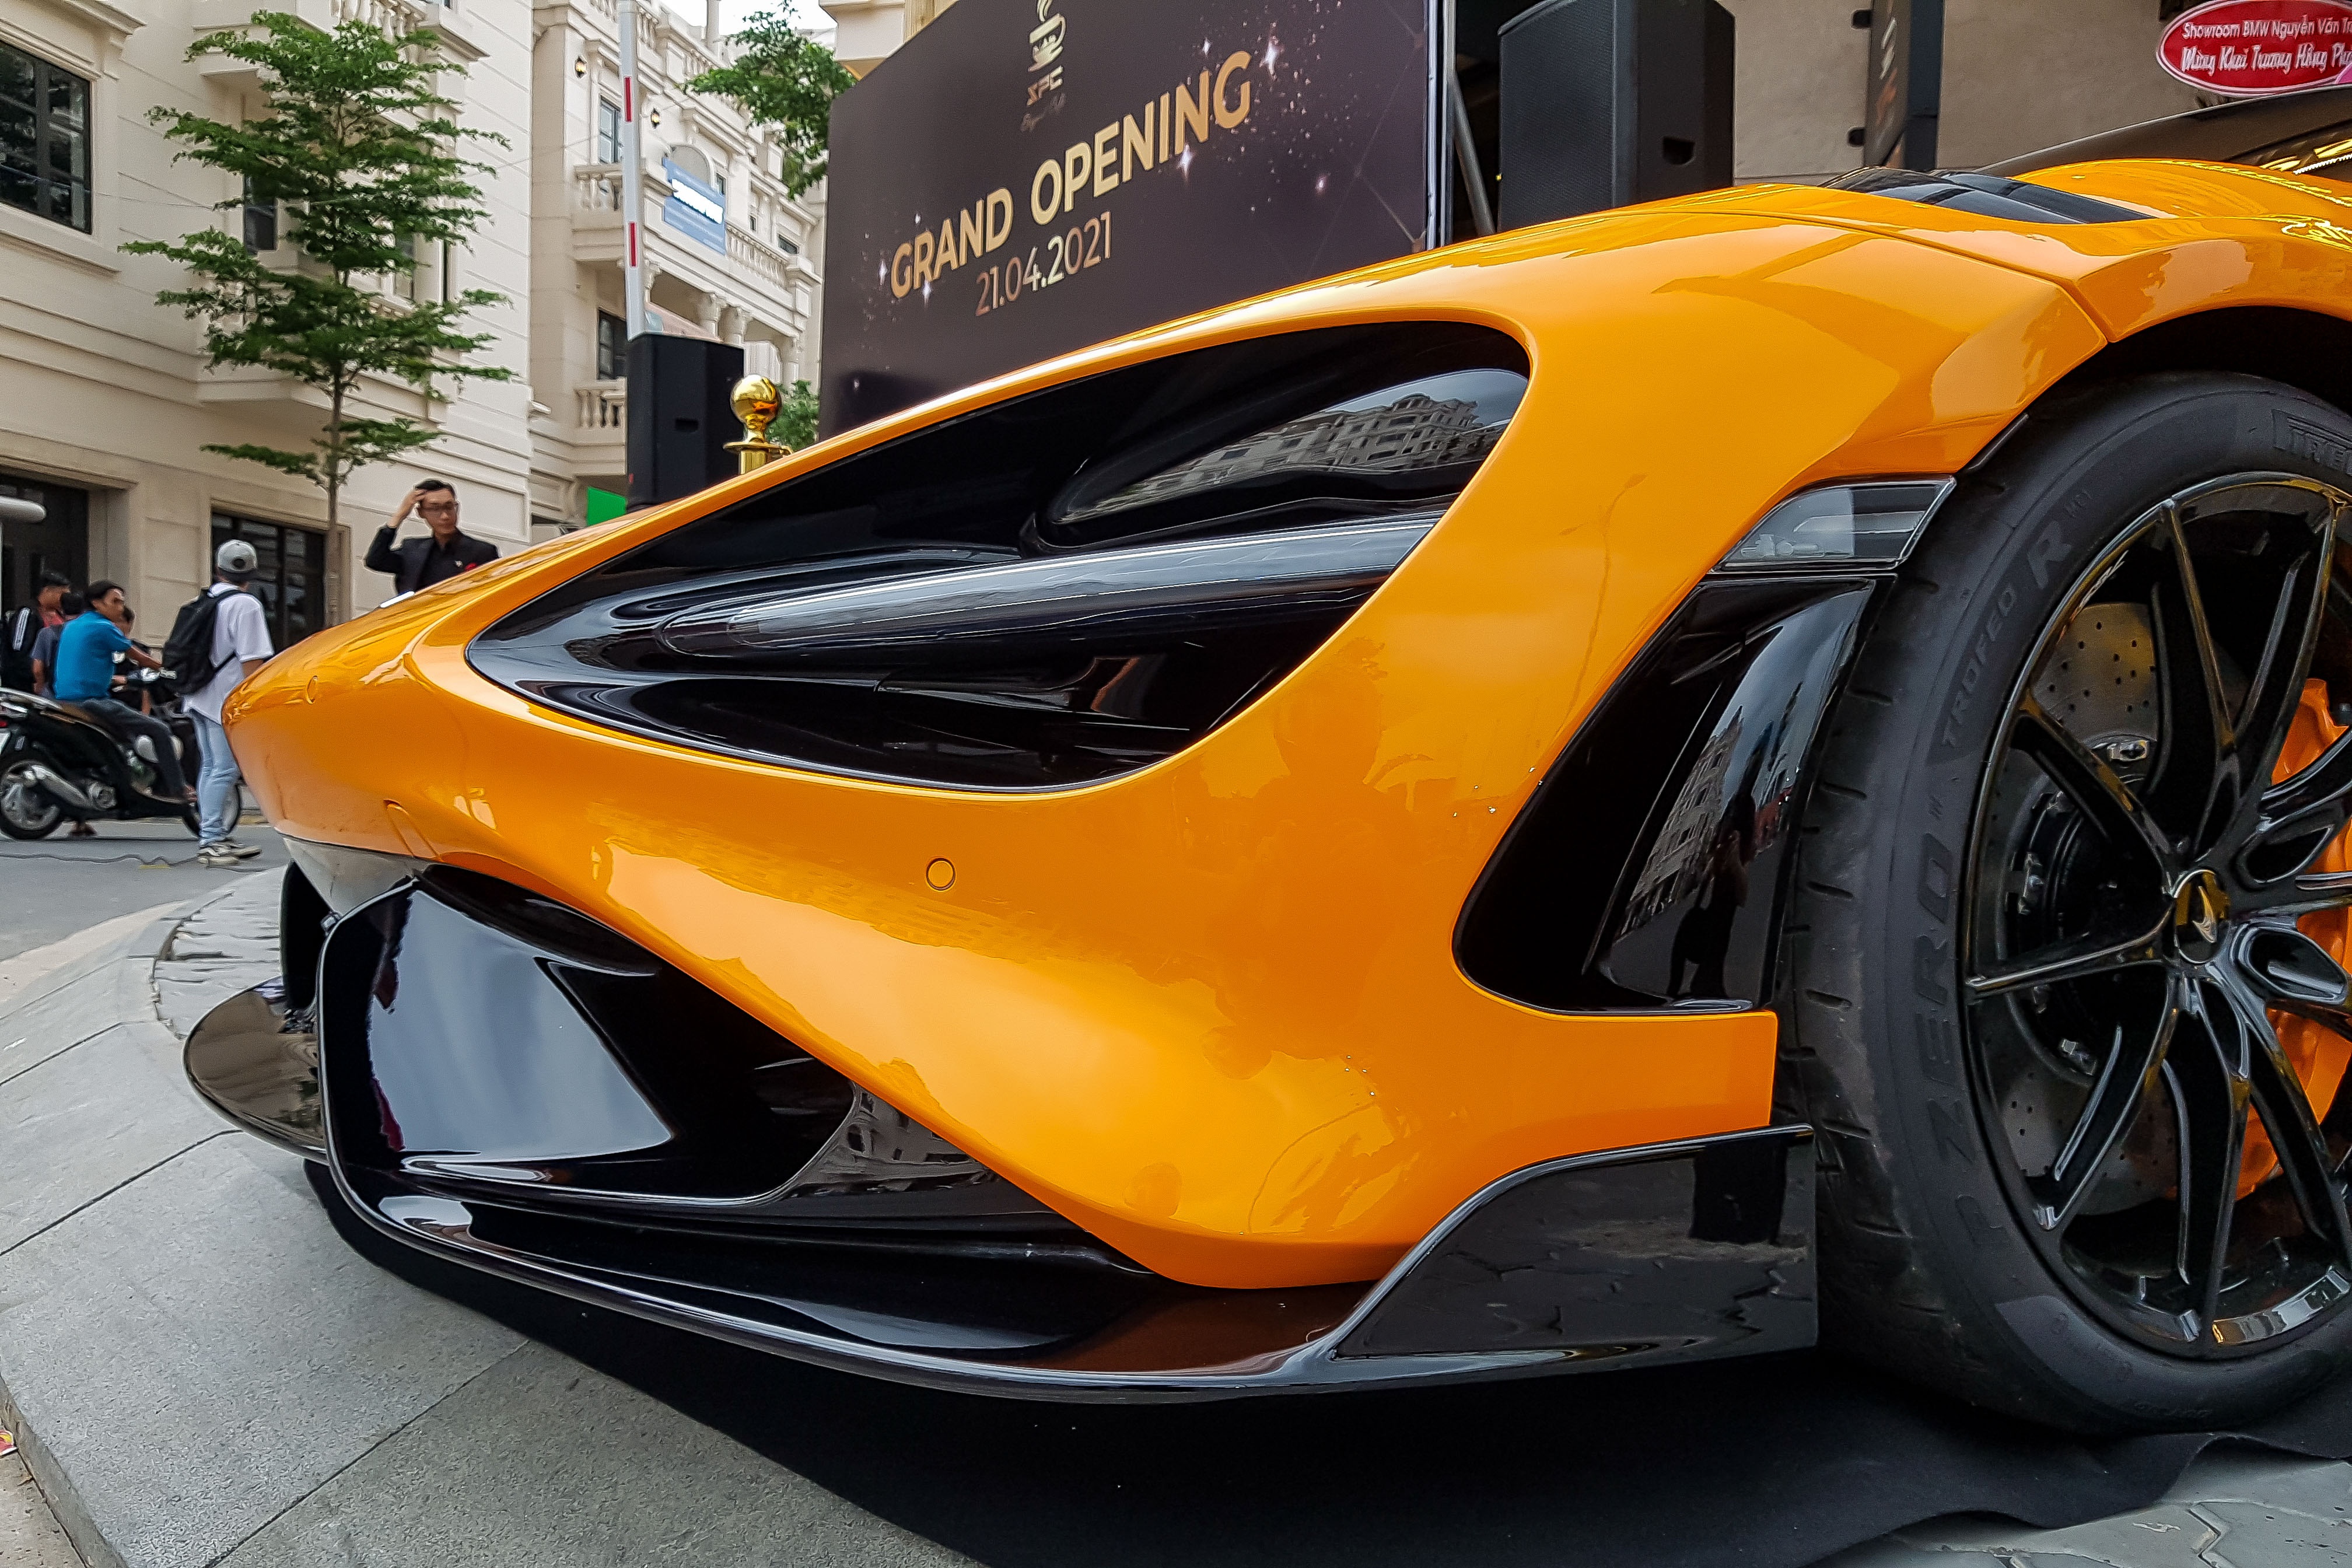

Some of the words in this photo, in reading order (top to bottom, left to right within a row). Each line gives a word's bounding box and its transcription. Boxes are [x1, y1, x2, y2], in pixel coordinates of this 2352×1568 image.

[2182, 22, 2241, 40] Showroom
[2242, 19, 2270, 37] BMW
[891, 187, 1013, 299] GRAND
[1030, 51, 1252, 225] OPENING
[975, 211, 1111, 317] 21.04.2021
[1941, 584, 2016, 749] TROFEO
[2027, 520, 2073, 589] R
[1913, 832, 1976, 1165] ZERO
